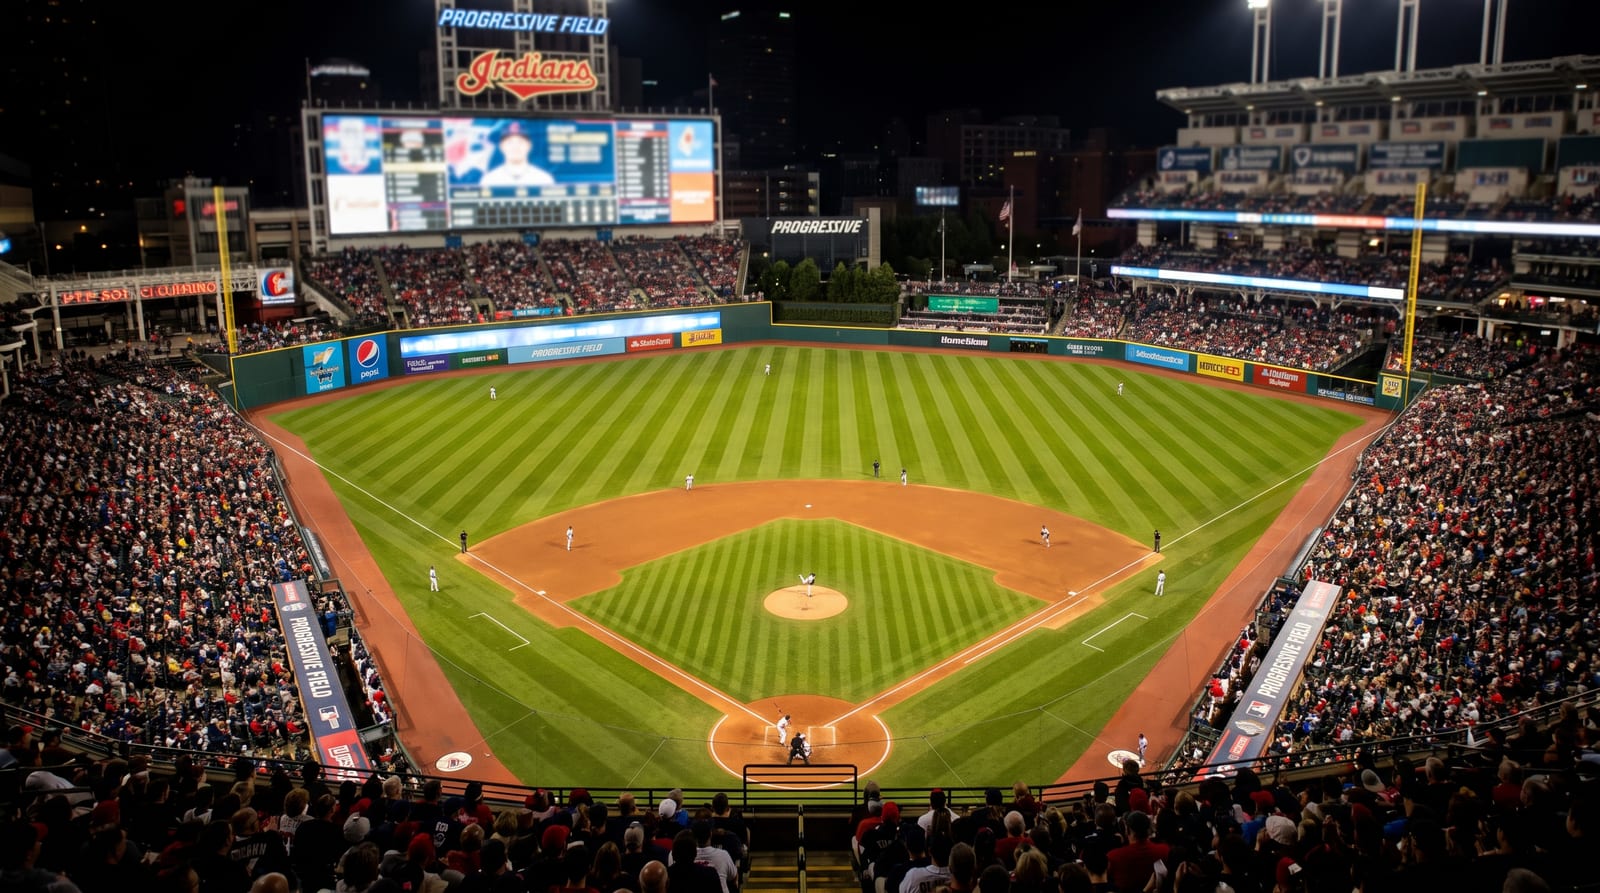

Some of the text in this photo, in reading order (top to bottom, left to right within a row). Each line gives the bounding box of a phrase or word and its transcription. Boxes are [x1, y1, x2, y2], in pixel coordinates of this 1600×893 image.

[438, 9, 610, 34] PROGRESSIVE FIELD
[456, 50, 598, 100] Indians
[771, 220, 863, 234] PROGRESSIVE
[531, 343, 603, 358] PROGRESSIVE FIELD
[360, 368, 379, 380] pepsi
[289, 616, 324, 670] PROGRESSIVE
[1257, 622, 1312, 699] PROGRESSIVE FIELD
[306, 668, 333, 698] FIELD
